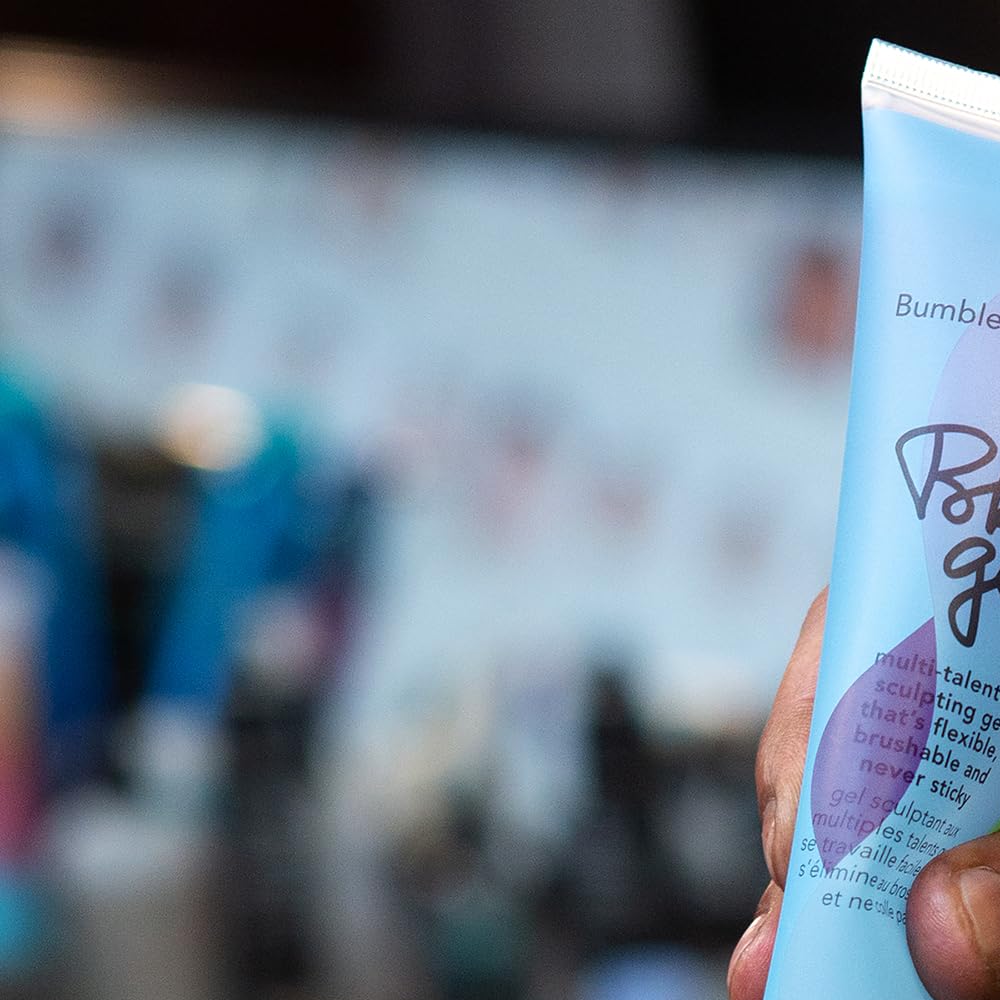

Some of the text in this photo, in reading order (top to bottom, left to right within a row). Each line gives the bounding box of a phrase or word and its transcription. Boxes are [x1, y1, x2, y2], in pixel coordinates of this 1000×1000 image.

[874, 679, 976, 724] sculpting
[853, 724, 992, 784] brushable and
[860, 700, 998, 762] that's flexible,
[859, 757, 971, 810] never sticky
[829, 787, 867, 808] gel
[870, 800, 947, 833] sculptant
[800, 837, 922, 877] se travaille facile
[812, 809, 940, 859] multiples talents
[822, 891, 843, 908] et
[848, 895, 874, 912] ne
[876, 878, 890, 893] au
[889, 878, 911, 901] bros
